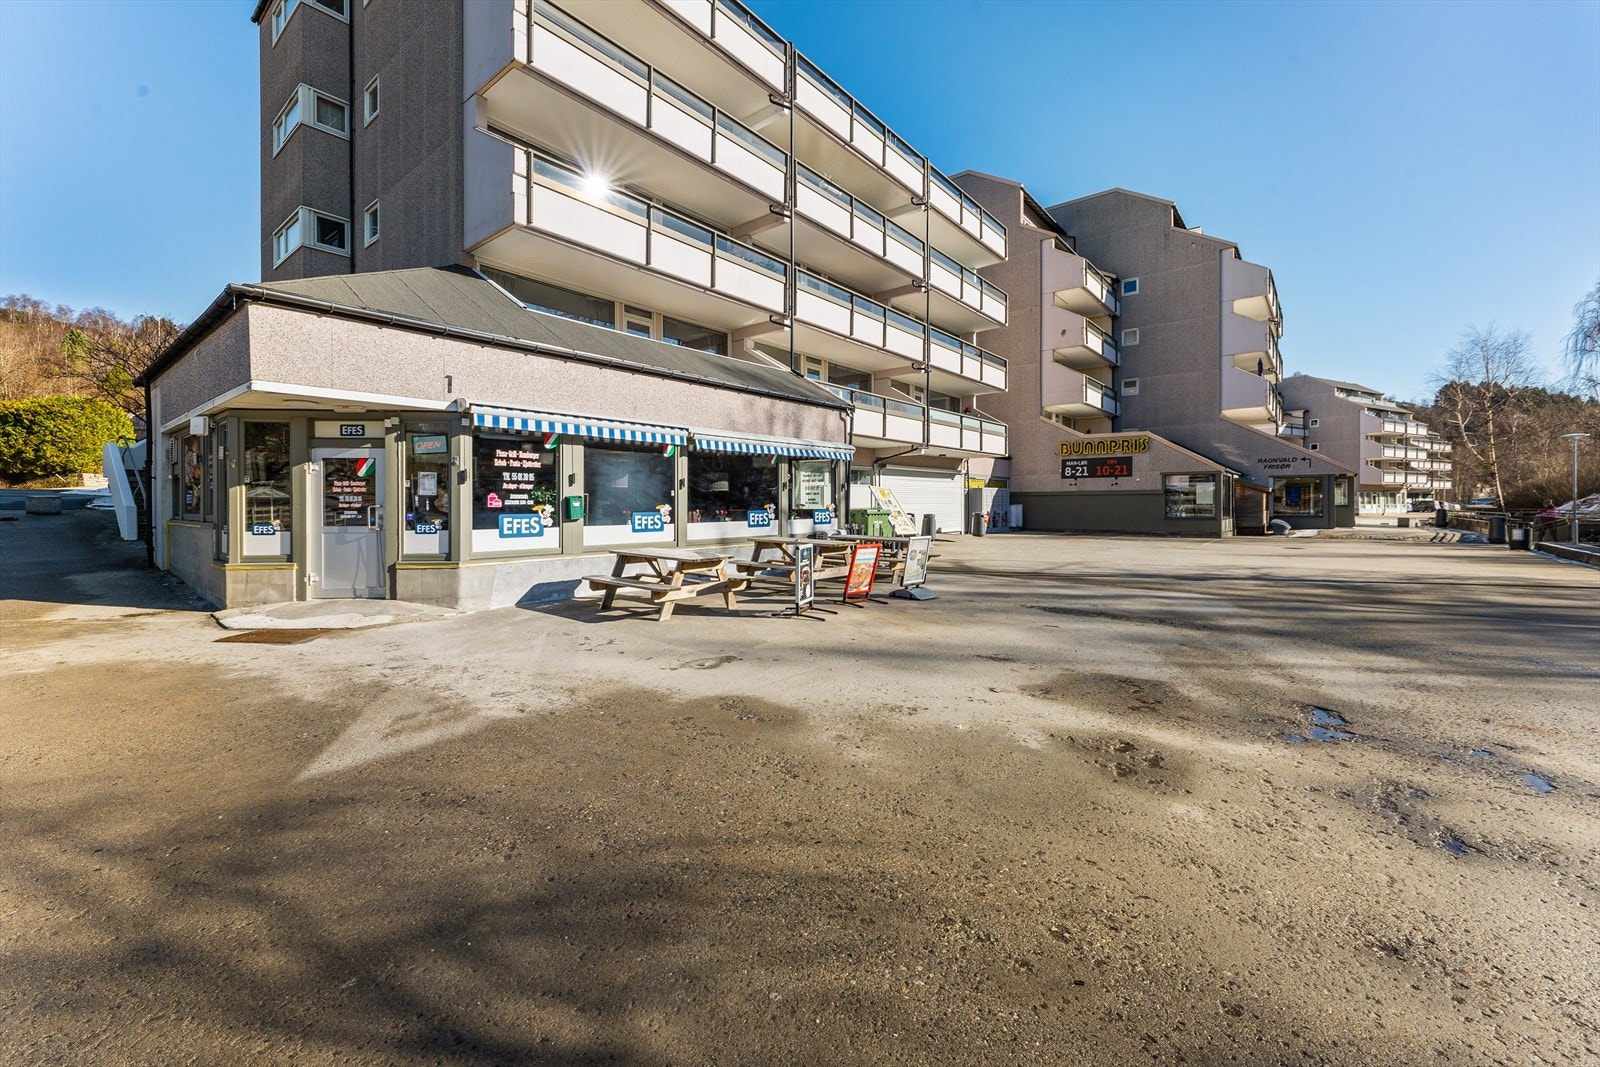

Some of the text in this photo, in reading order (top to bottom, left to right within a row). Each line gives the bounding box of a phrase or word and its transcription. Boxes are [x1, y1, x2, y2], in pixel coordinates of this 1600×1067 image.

[342, 425, 363, 435] EFES
[415, 441, 441, 450] OPEN
[1059, 436, 1149, 457] BUNNPRIS
[1065, 466, 1089, 476] 8-21
[1096, 465, 1128, 476] 10-21
[634, 514, 662, 530] EFES
[749, 513, 769, 525] EFES
[814, 511, 830, 523] EFES
[253, 525, 274, 534] EFES
[417, 525, 436, 533] EFES
[503, 517, 540, 535] EFES
